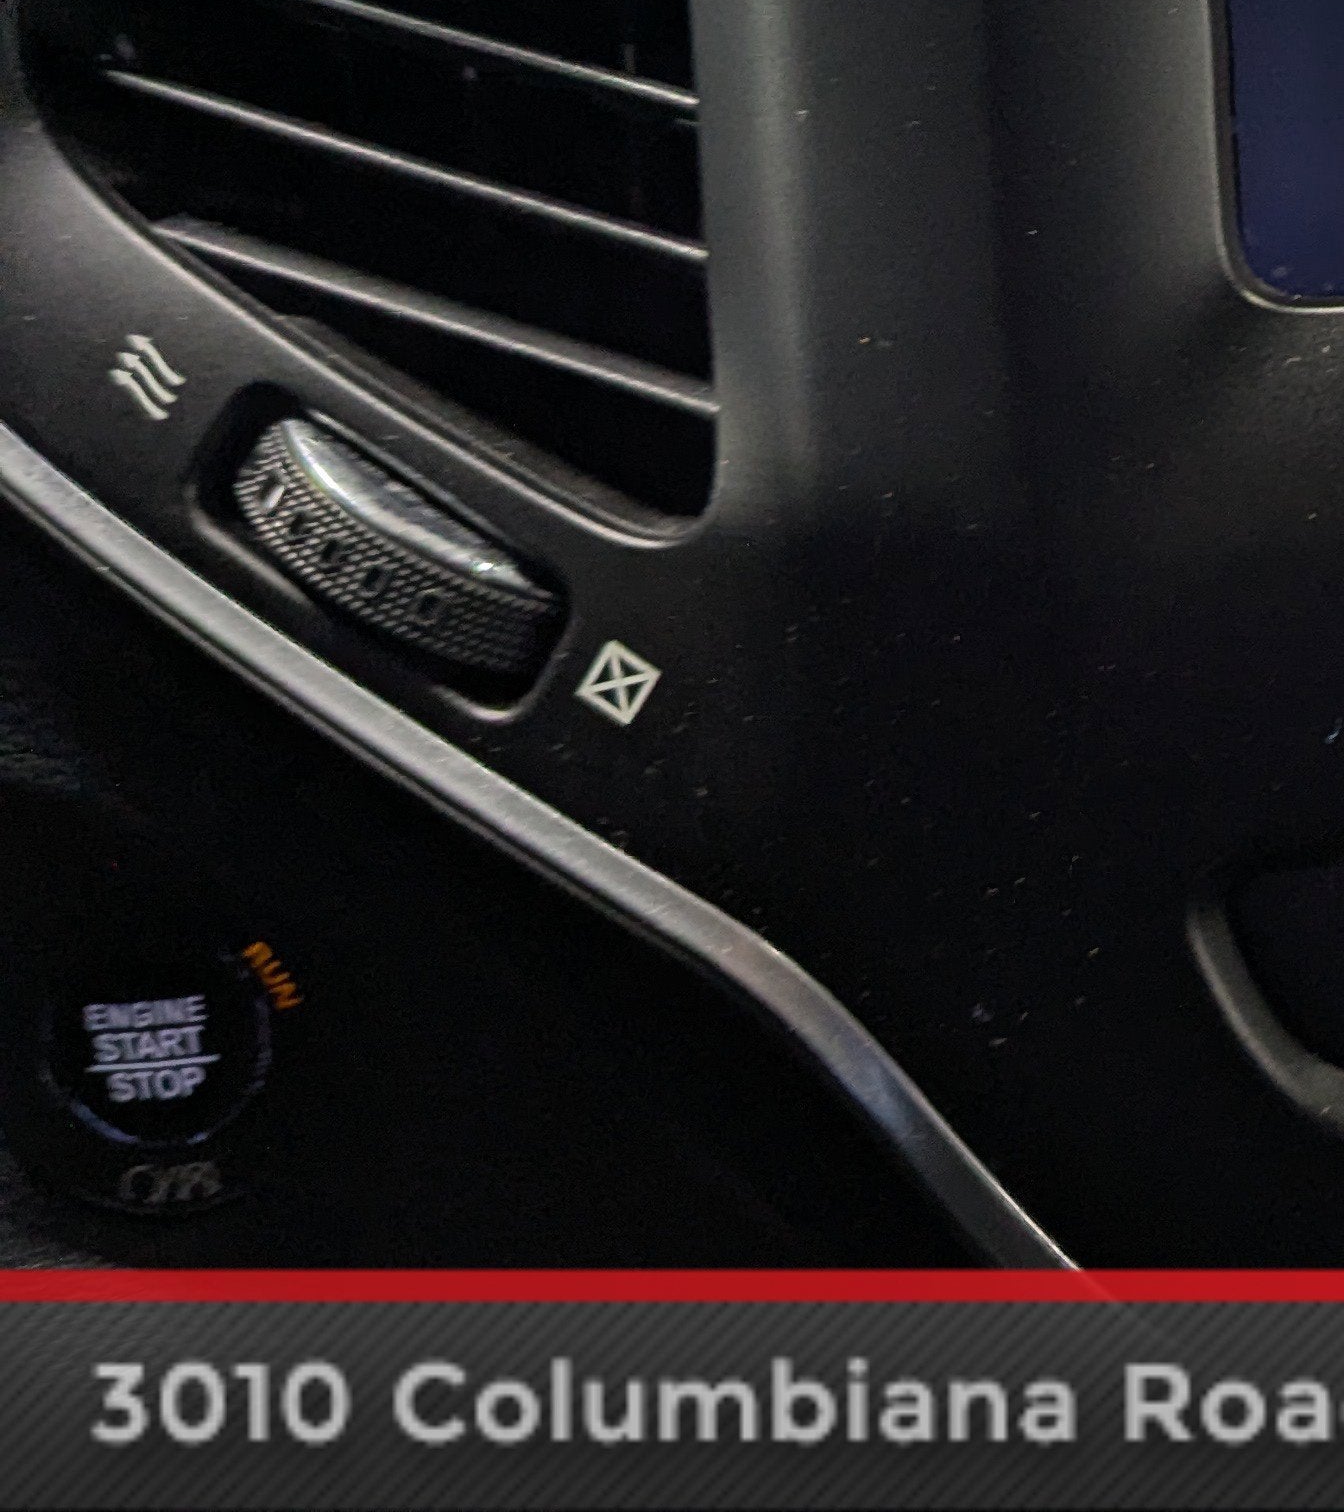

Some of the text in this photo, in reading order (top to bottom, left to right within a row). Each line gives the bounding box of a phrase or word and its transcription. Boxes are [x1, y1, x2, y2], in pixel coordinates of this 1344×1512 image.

[83, 995, 207, 1031] ENGINE
[94, 1026, 205, 1063] START
[106, 1067, 207, 1103] STOP
